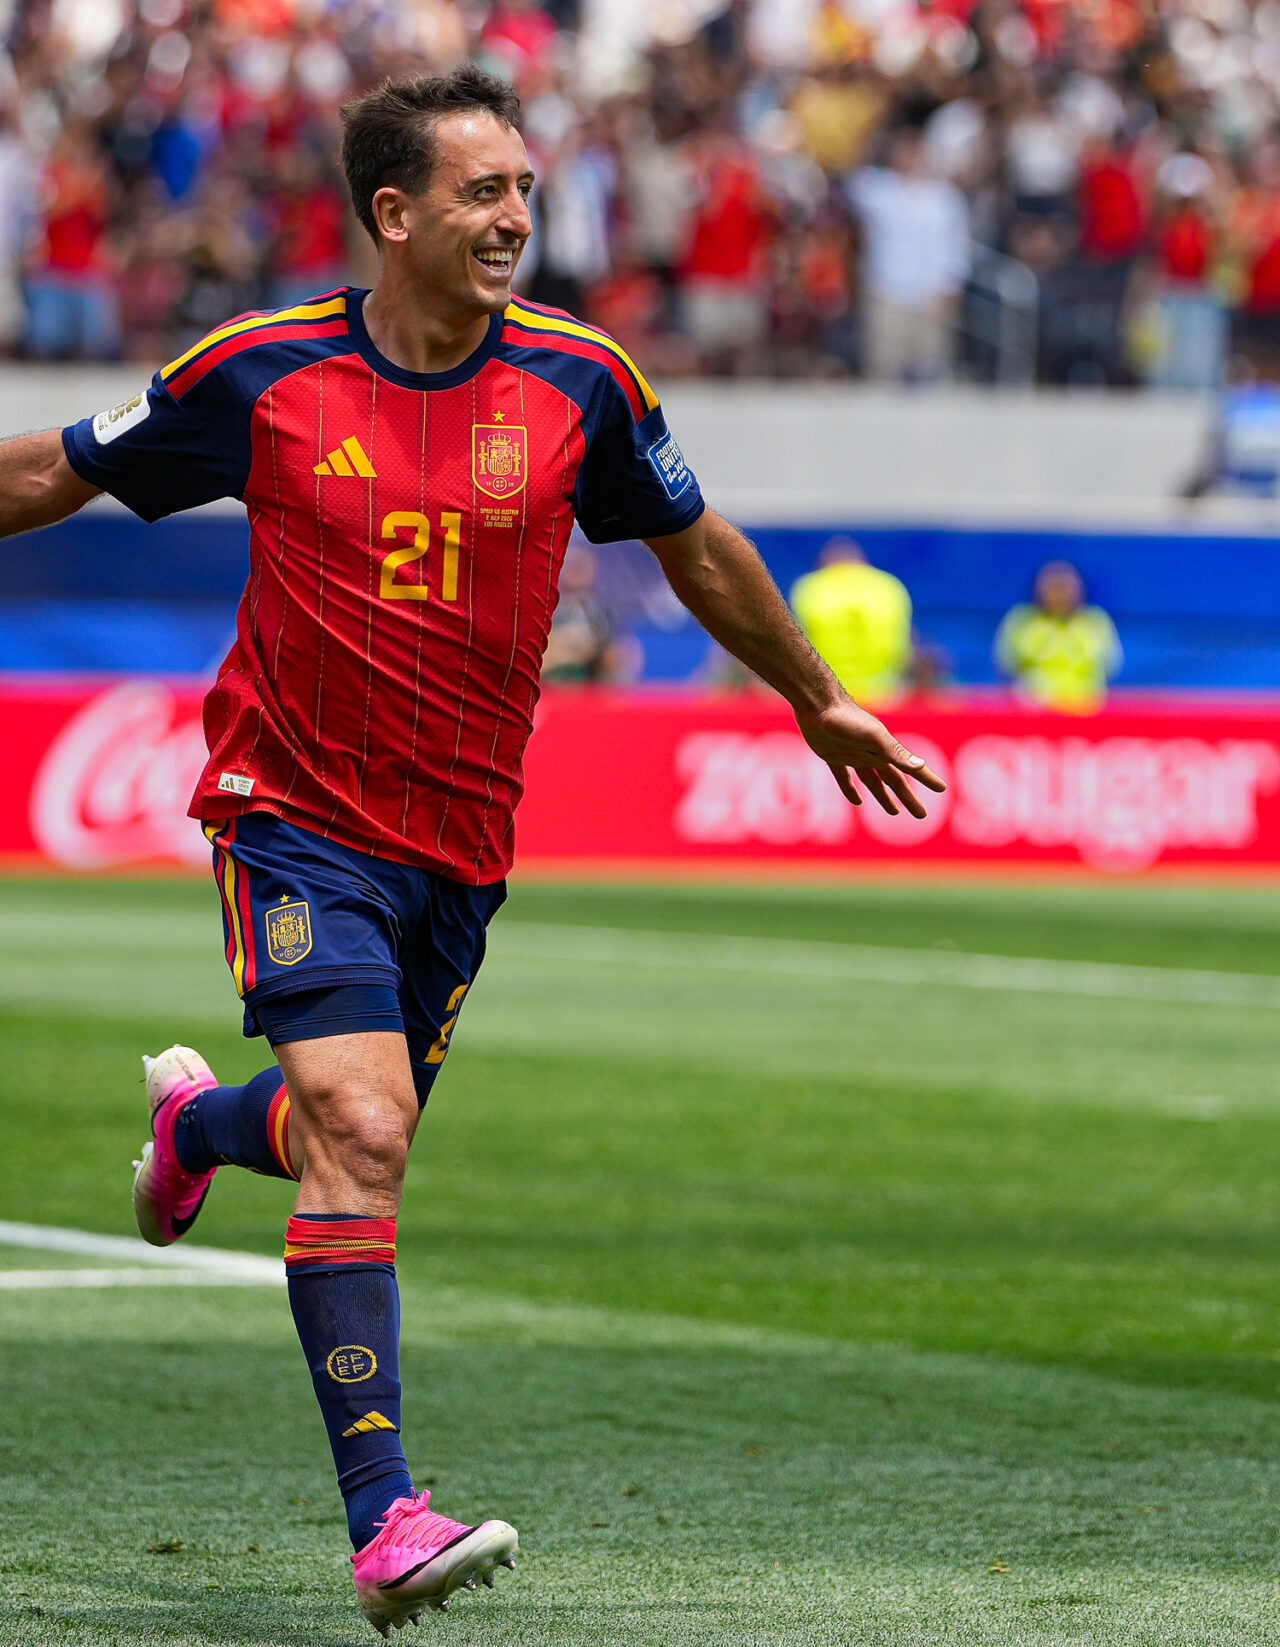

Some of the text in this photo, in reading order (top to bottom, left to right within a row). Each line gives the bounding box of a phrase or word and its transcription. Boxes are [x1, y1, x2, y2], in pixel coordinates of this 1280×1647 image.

[379, 511, 461, 601] 21
[951, 733, 1280, 875] sugar
[336, 1353, 363, 1365] RF
[338, 1364, 365, 1376] EF
